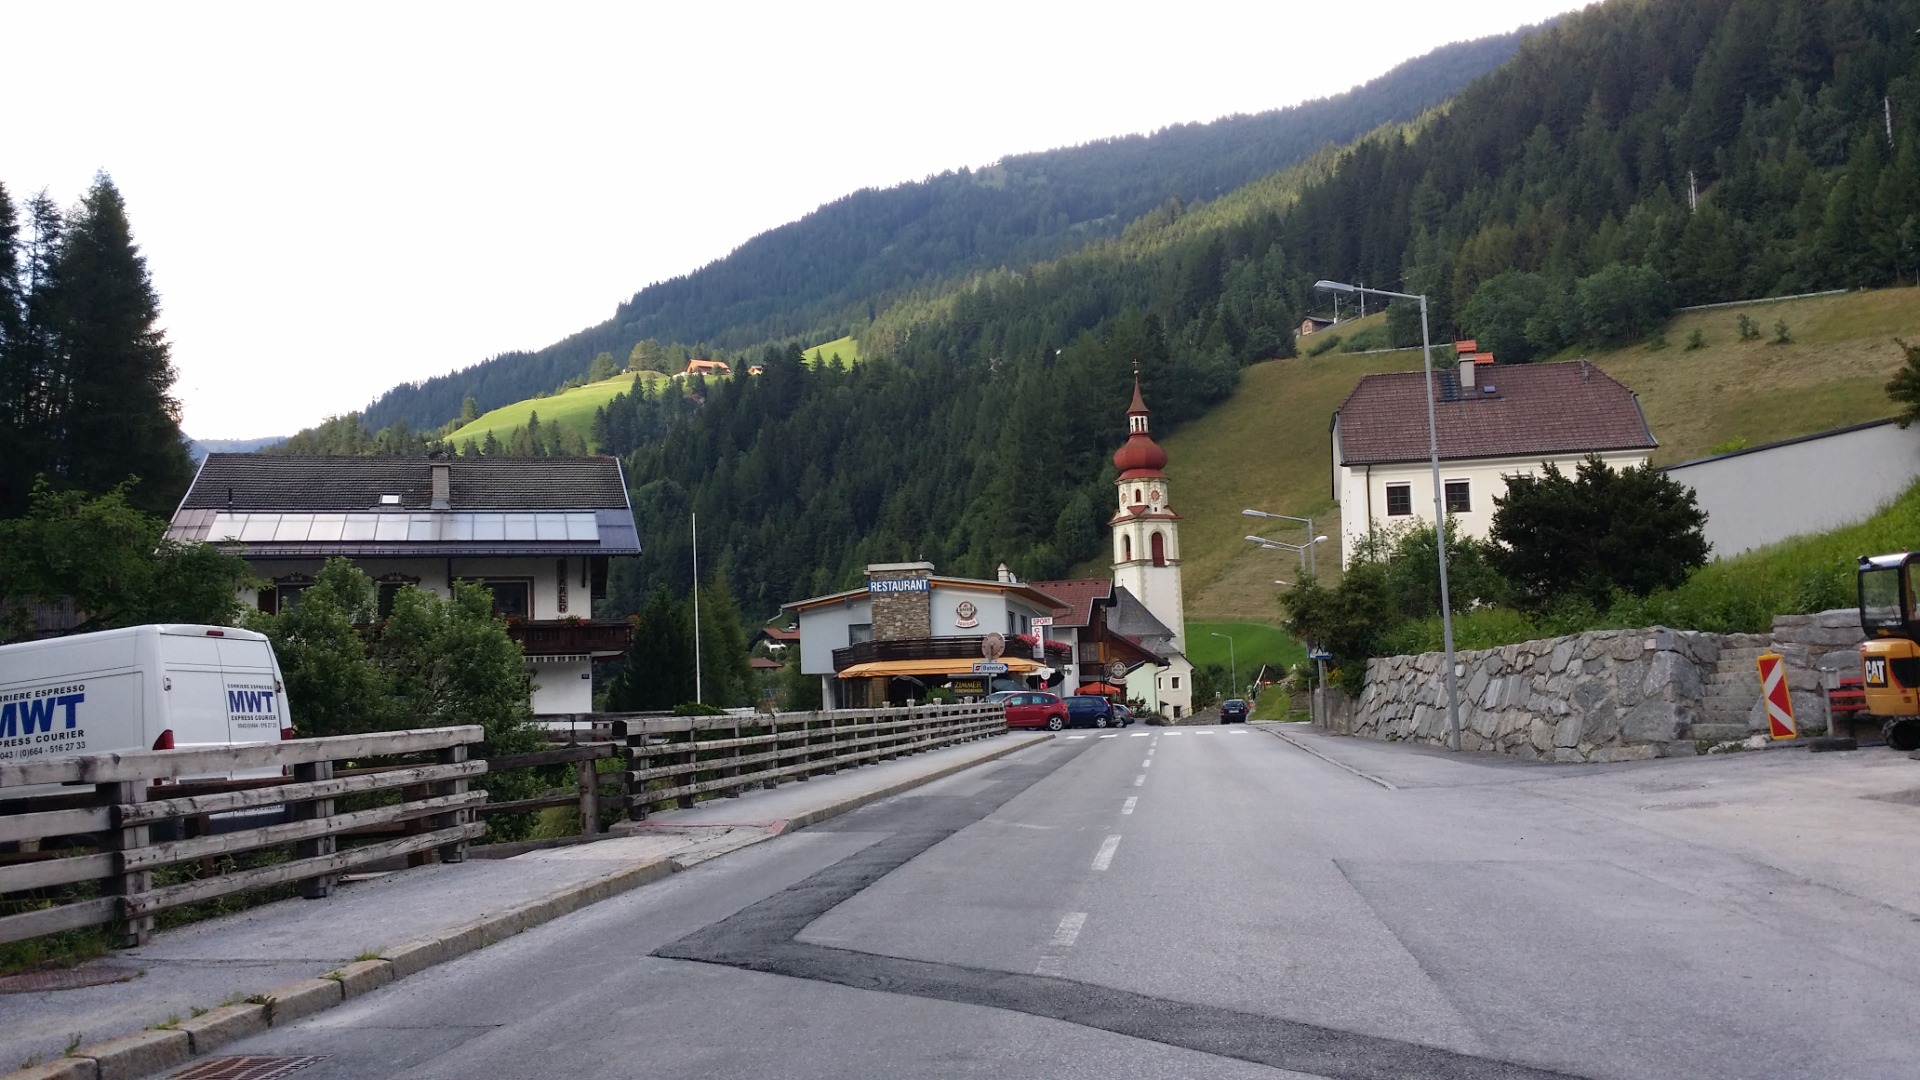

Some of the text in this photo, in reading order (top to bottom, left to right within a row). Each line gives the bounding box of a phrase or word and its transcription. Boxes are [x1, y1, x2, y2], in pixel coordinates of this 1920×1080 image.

[870, 579, 928, 592] RESTAURANT
[1865, 660, 1884, 684] CAT
[35, 684, 85, 697] ESPRESSO
[228, 690, 274, 713] MWT
[36, 729, 84, 743] COURIER
[20, 747, 43, 759] (0)664
[49, 744, 63, 753] 516
[65, 743, 74, 751] 27
[76, 741, 86, 749] 33
